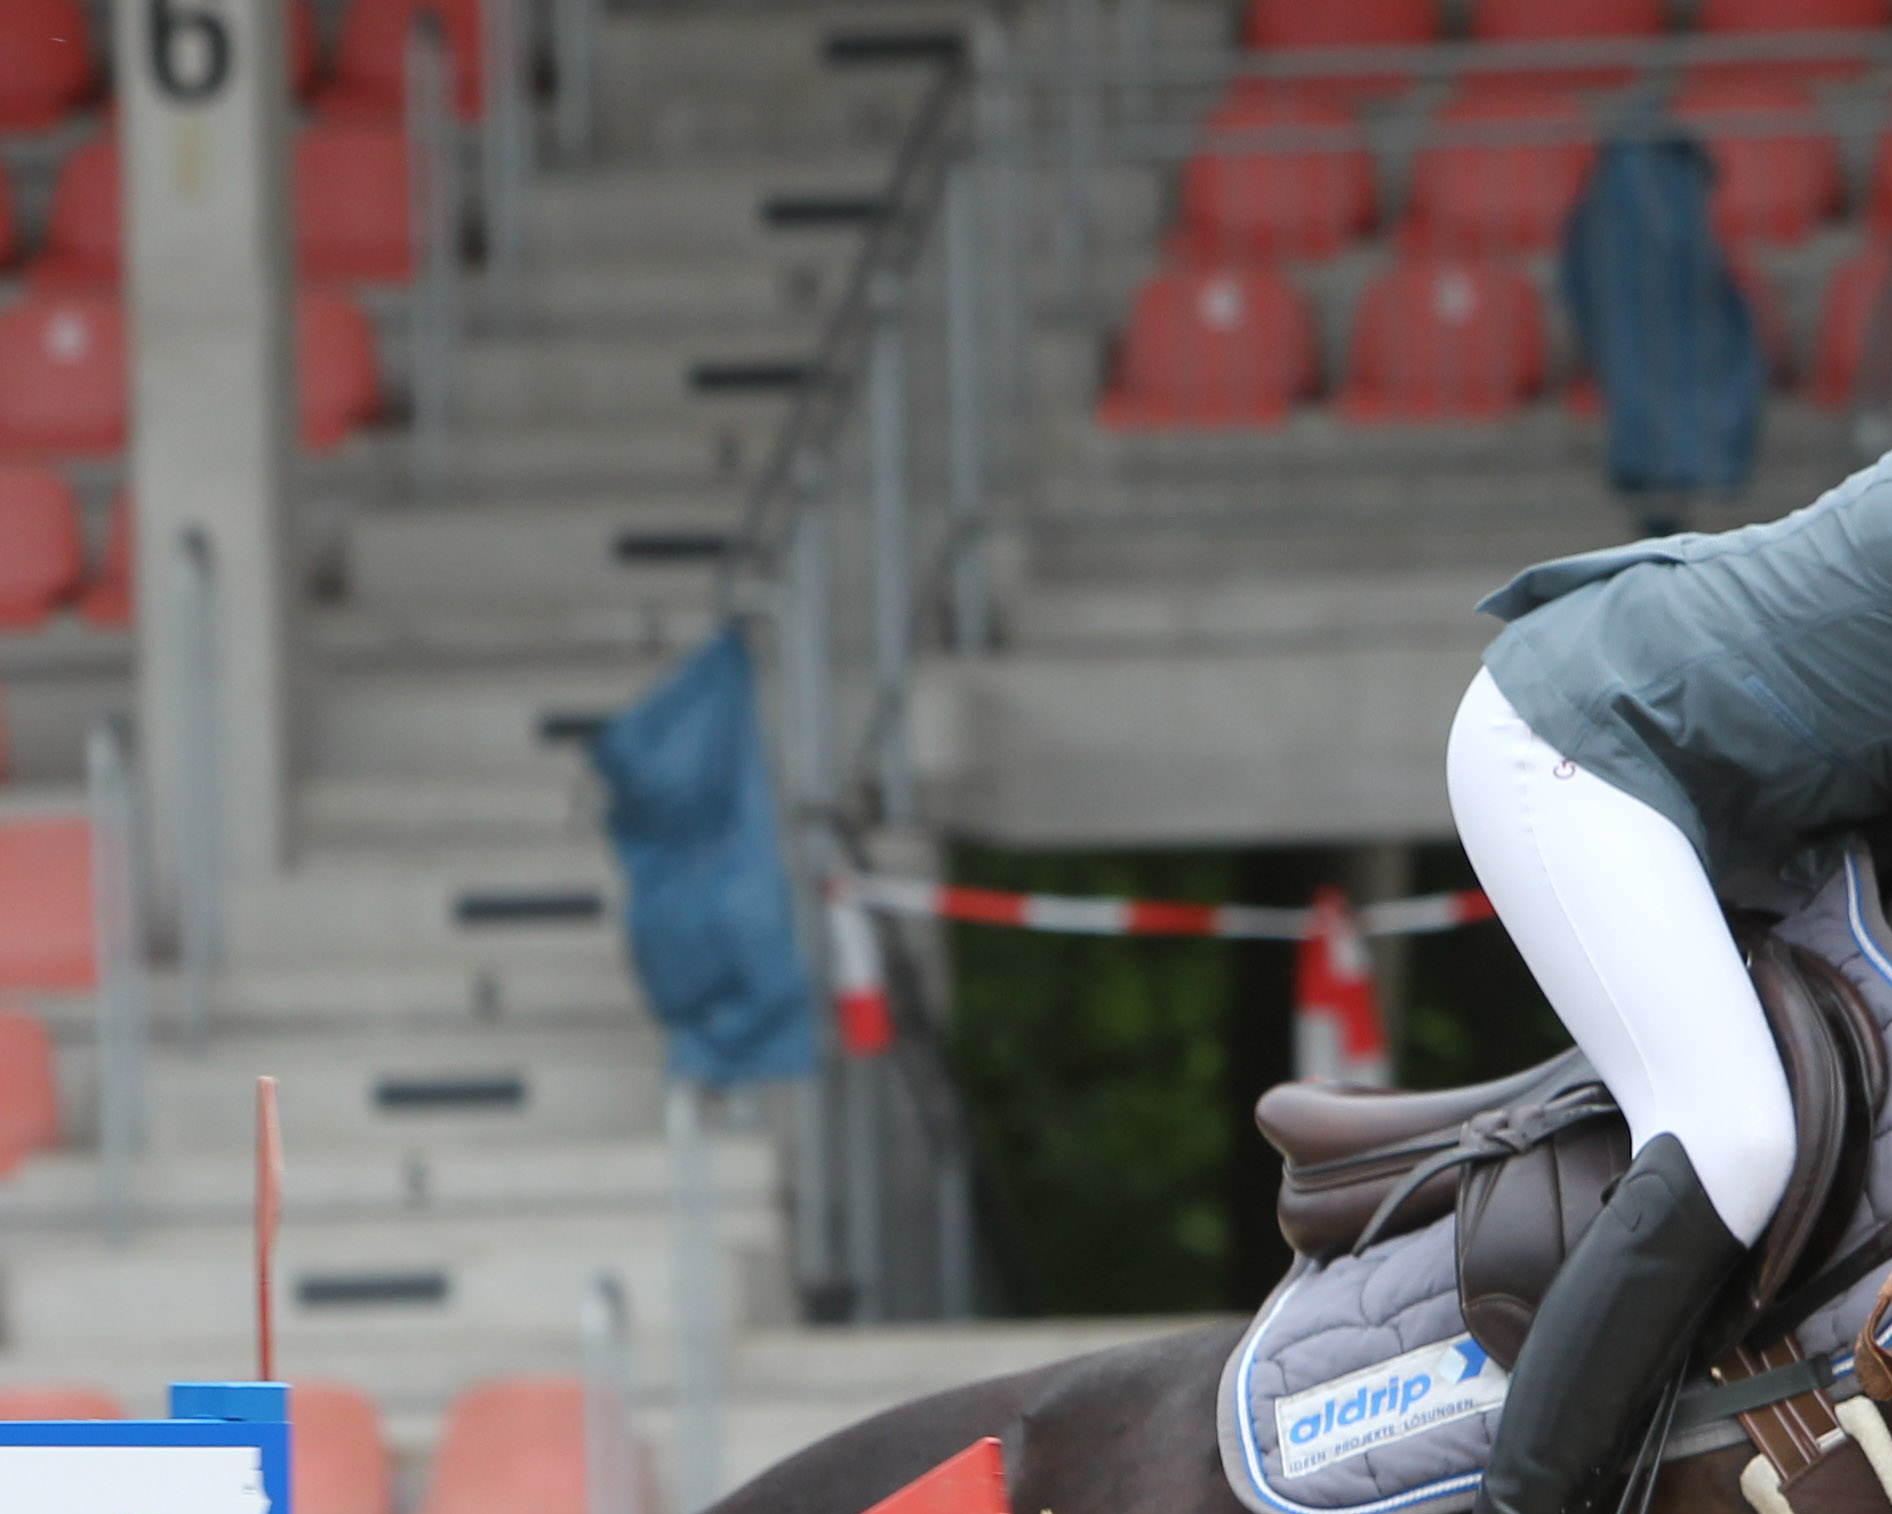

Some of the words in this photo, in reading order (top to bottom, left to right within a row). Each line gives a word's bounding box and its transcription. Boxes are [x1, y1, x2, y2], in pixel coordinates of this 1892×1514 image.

[1289, 1373, 1431, 1445] aldrip
[1289, 1451, 1327, 1475] IDEEN
[1334, 1423, 1396, 1456] PROJEKTE
[1403, 1397, 1474, 1433] LÖSUNGEN
